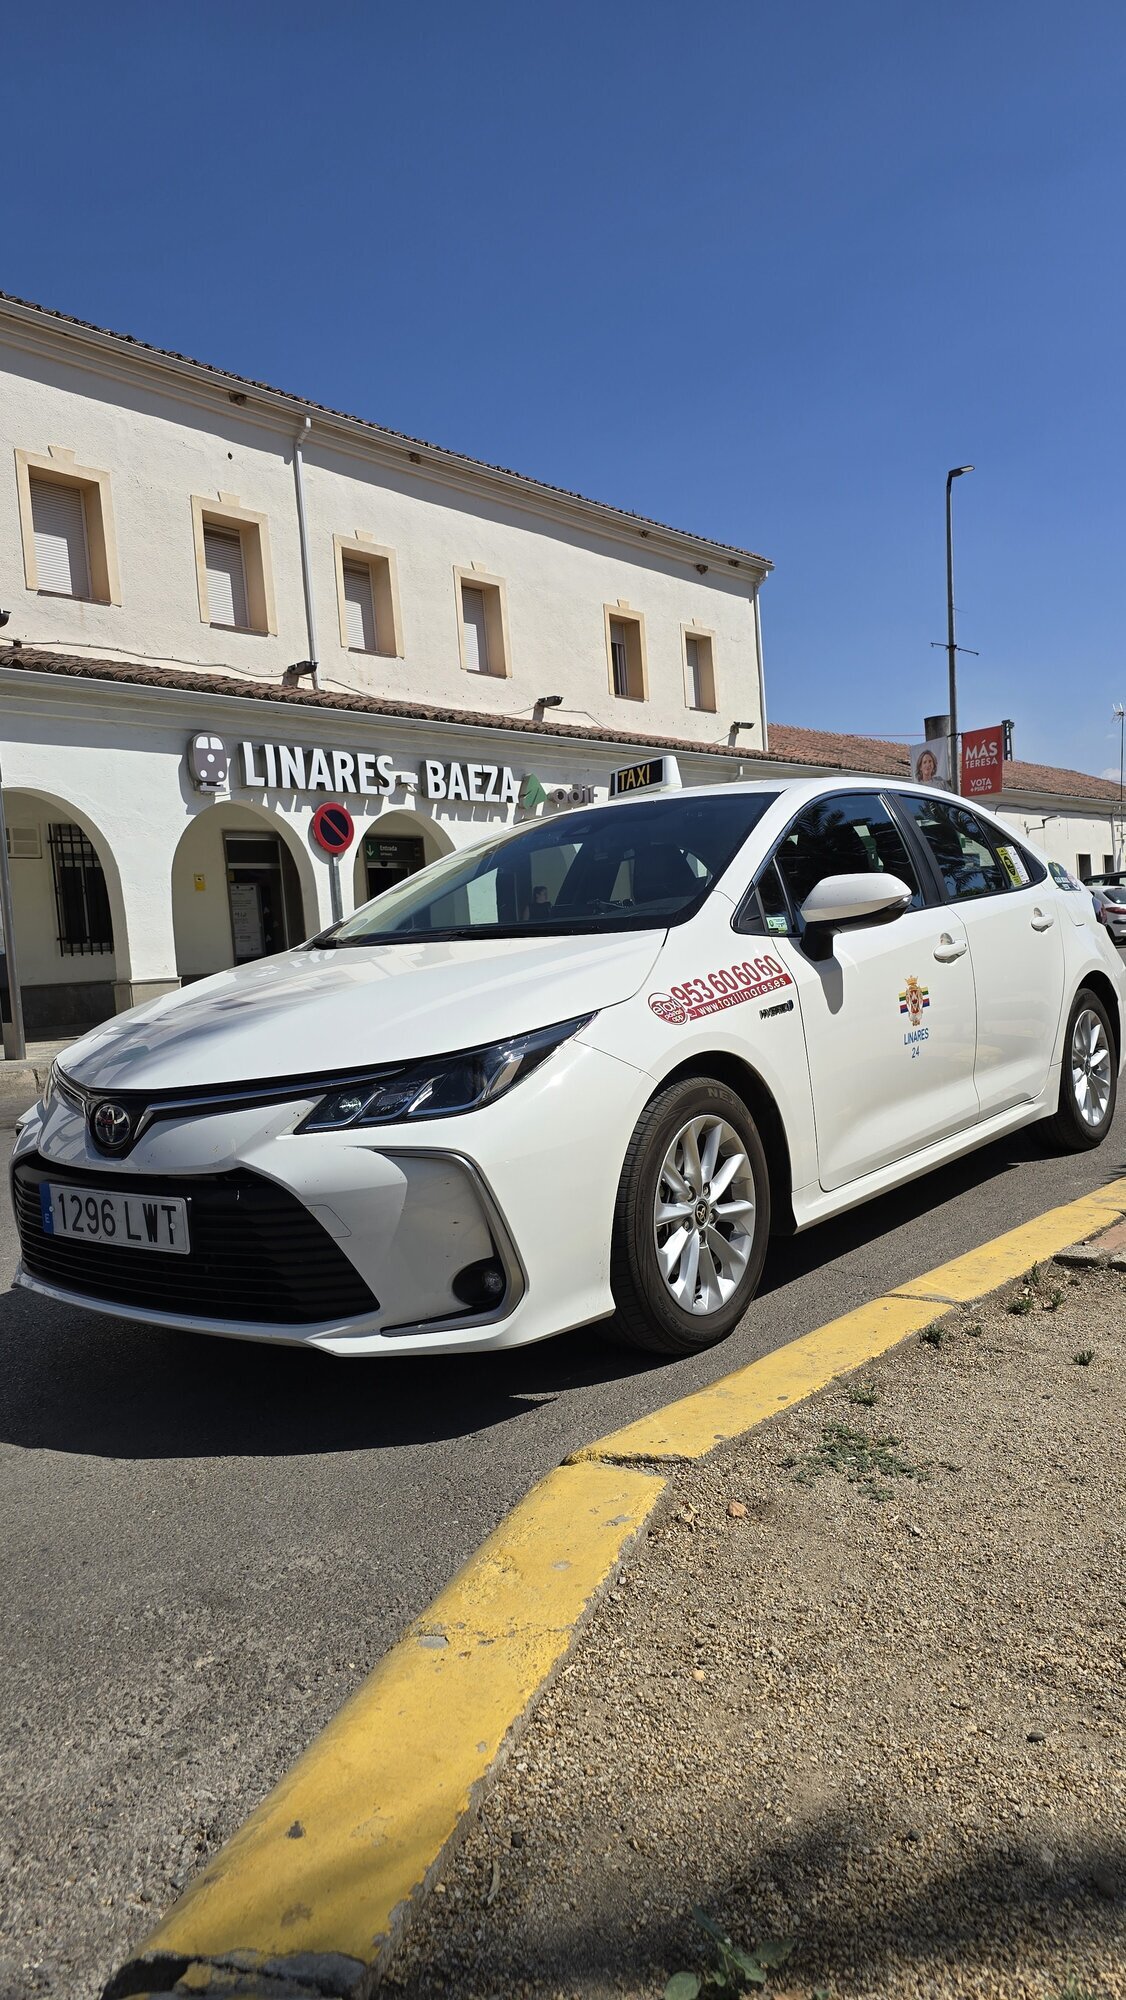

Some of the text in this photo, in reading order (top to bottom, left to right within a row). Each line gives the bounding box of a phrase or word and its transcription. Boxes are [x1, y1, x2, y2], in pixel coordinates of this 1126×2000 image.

[965, 740, 998, 761] MÁS
[965, 757, 998, 769] TERESA
[618, 764, 650, 791] TAXI
[970, 777, 992, 788] VOTA
[670, 978, 715, 1007] 953
[697, 976, 787, 1016] www.taxilinares.es
[903, 1027, 929, 1046] LINARES
[911, 1046, 920, 1059] 24
[45, 1193, 177, 1245] E 1296 LWT
